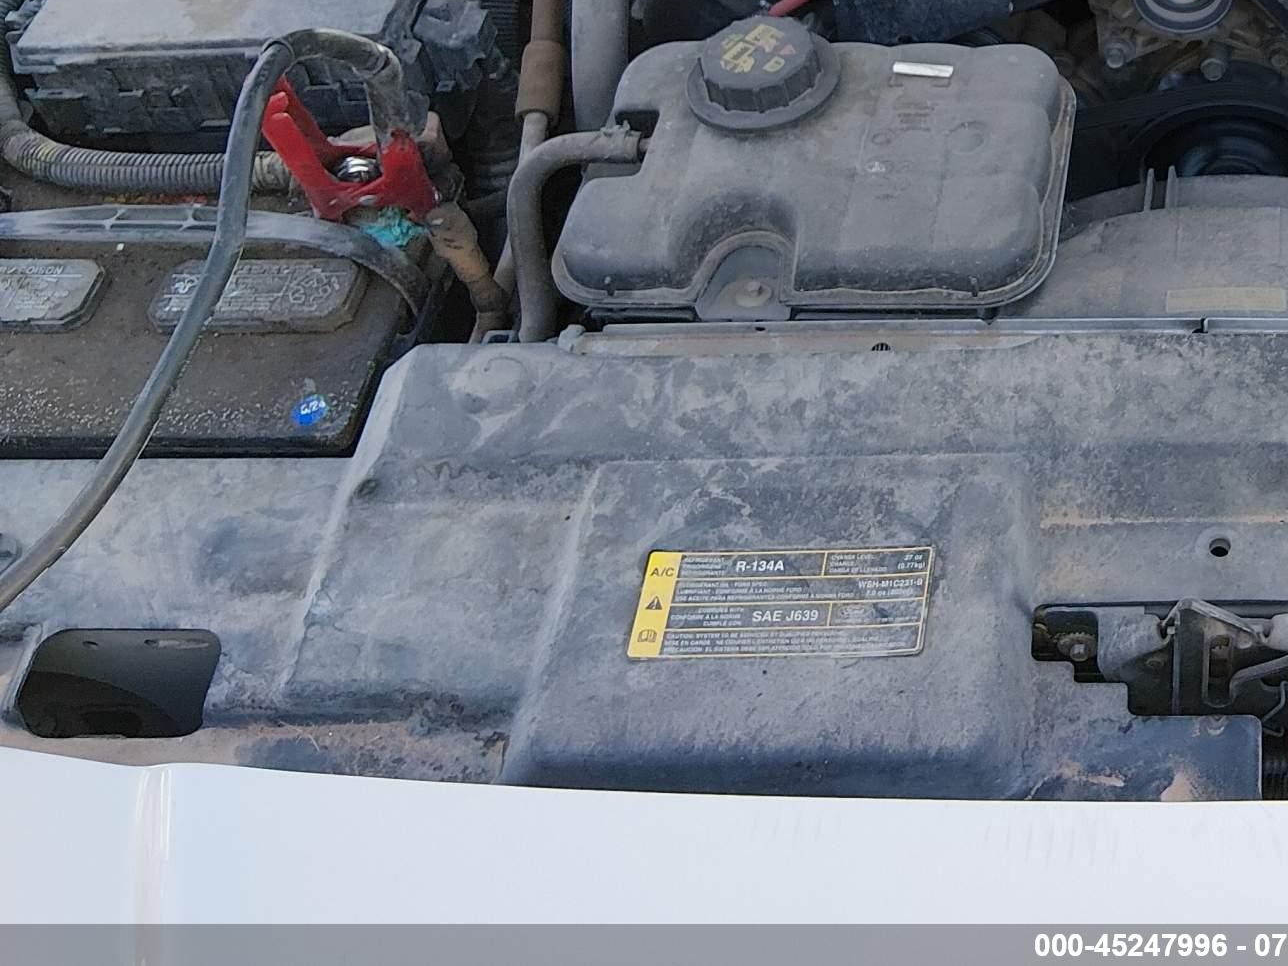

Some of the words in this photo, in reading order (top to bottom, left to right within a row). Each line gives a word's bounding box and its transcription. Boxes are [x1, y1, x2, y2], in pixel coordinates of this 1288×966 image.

[650, 567, 675, 577] A/C
[735, 560, 785, 572] R-134A
[752, 610, 783, 622] SAE
[785, 609, 819, 622] J639
